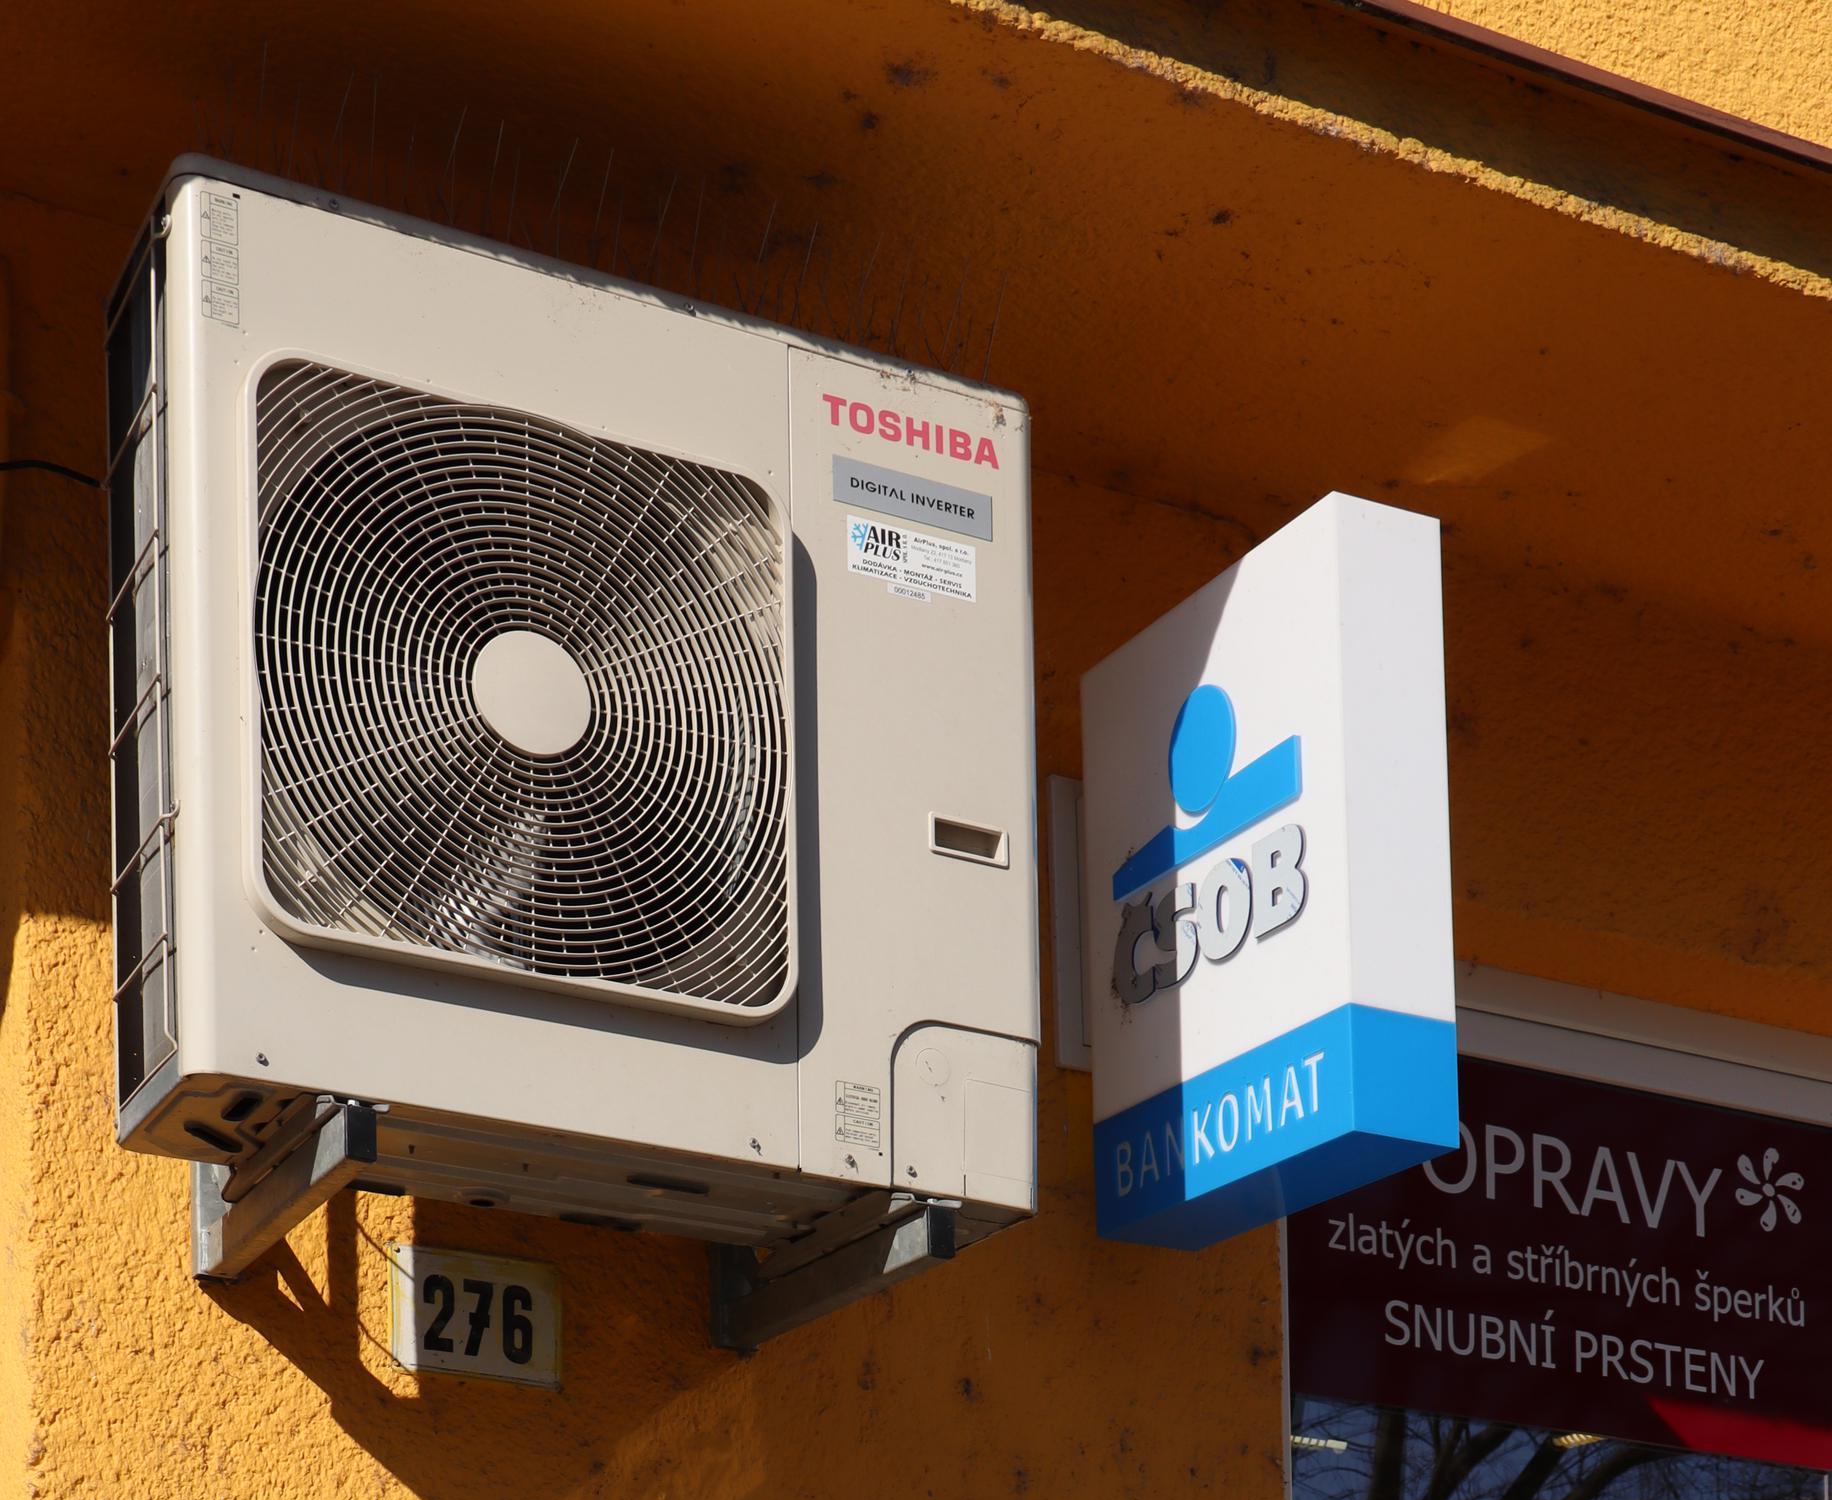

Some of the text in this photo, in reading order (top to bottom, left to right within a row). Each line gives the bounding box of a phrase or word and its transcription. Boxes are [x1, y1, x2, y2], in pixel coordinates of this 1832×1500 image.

[822, 393, 1000, 470] TOSHIBA
[850, 476, 975, 520] DIGITAL INVERTER
[862, 558, 962, 589] DODÁVKA MONTÁŽ SERVIS
[864, 542, 901, 562] PLUS
[867, 526, 901, 549] AIR
[852, 564, 972, 599] KLIMATIZACE VZDUCHOTECHNIKA
[1114, 823, 1307, 1004] ČSOB
[1116, 1052, 1324, 1197] BANKOMAT
[1328, 1213, 1806, 1327] zlatých a stříbrných šperků
[423, 1274, 533, 1365] 276
[1384, 1299, 1765, 1400] SNUBNÍ PRSTENY
